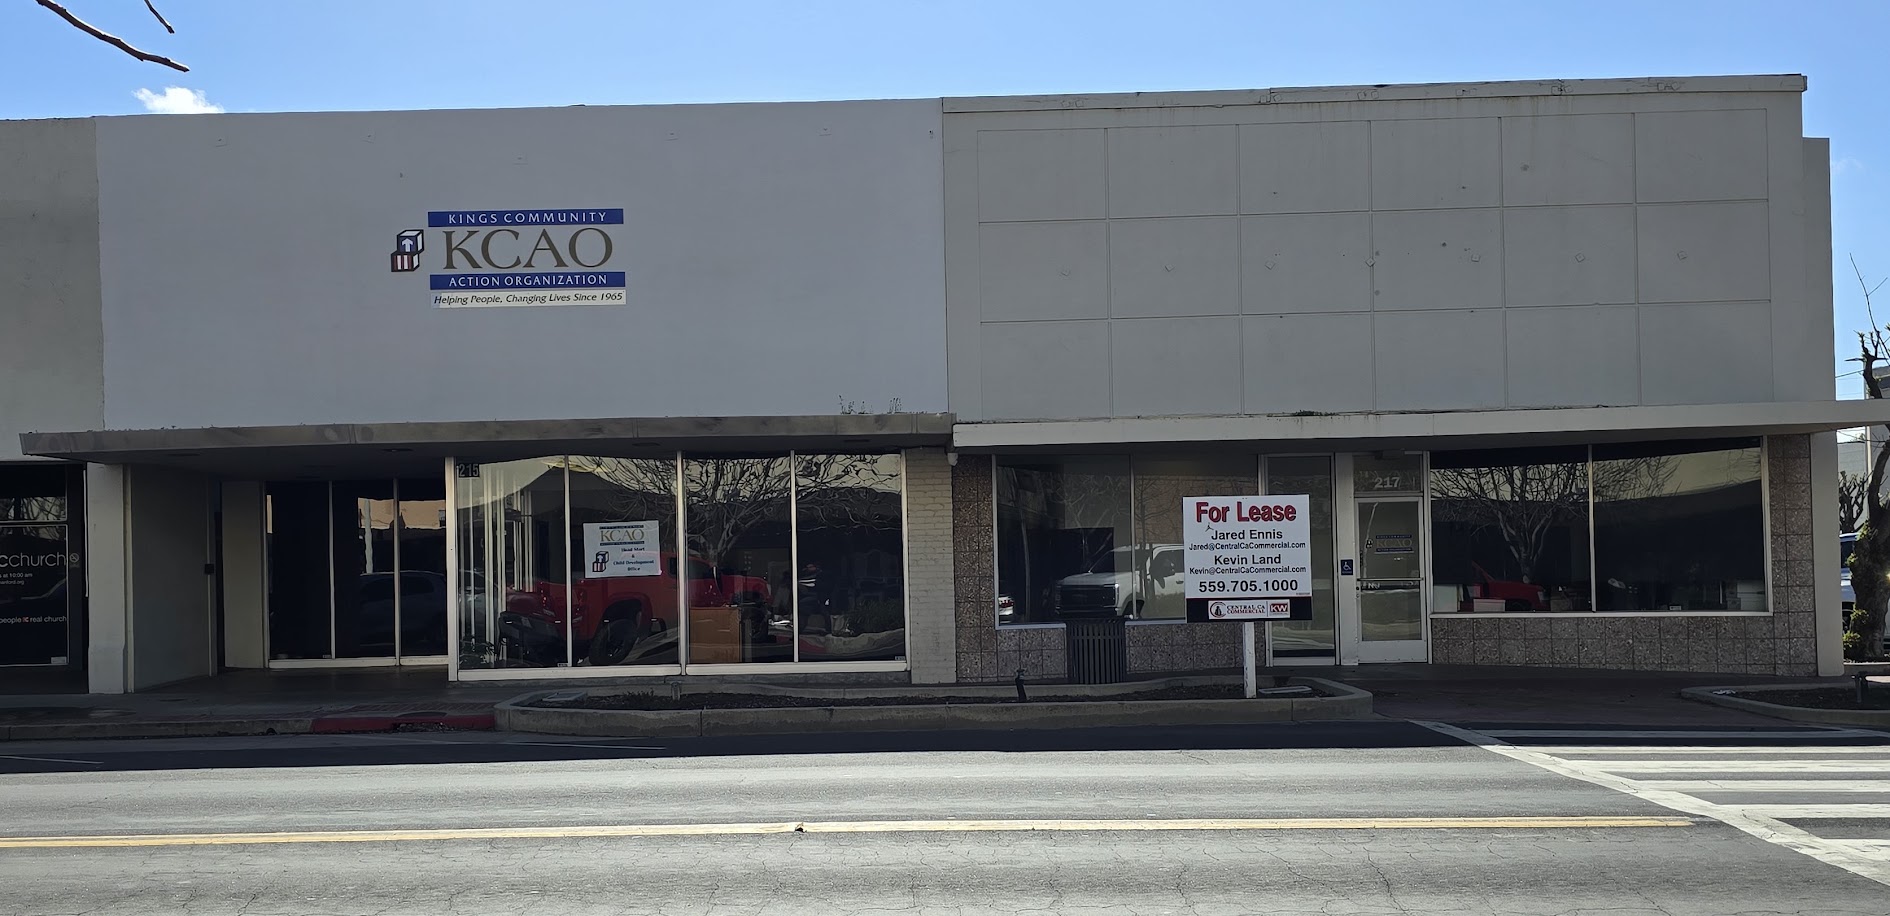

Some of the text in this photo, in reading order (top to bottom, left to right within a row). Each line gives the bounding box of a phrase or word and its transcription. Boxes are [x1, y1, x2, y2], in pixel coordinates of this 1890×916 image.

[448, 211, 607, 225] KINGS COMMUNITY
[442, 227, 613, 270] KCAO
[449, 274, 607, 287] ACTION ORGANIZATION
[433, 292, 623, 306] Helping People, Changing Lives Since 1965
[459, 463, 479, 477] 215
[1374, 476, 1400, 488] 217
[1195, 500, 1297, 523] For Lease
[601, 529, 644, 541] KCAO
[1211, 529, 1283, 541] Jared Ennis
[1188, 542, 1306, 551] Jared@CentralCaCommercial.com
[1214, 554, 1282, 565] Kevin Land
[1189, 566, 1307, 575] Kevin@CentralCaCommercial.com
[1198, 579, 1299, 593] 559.705.1000
[1270, 604, 1288, 612] KW
[43, 615, 67, 623] church
